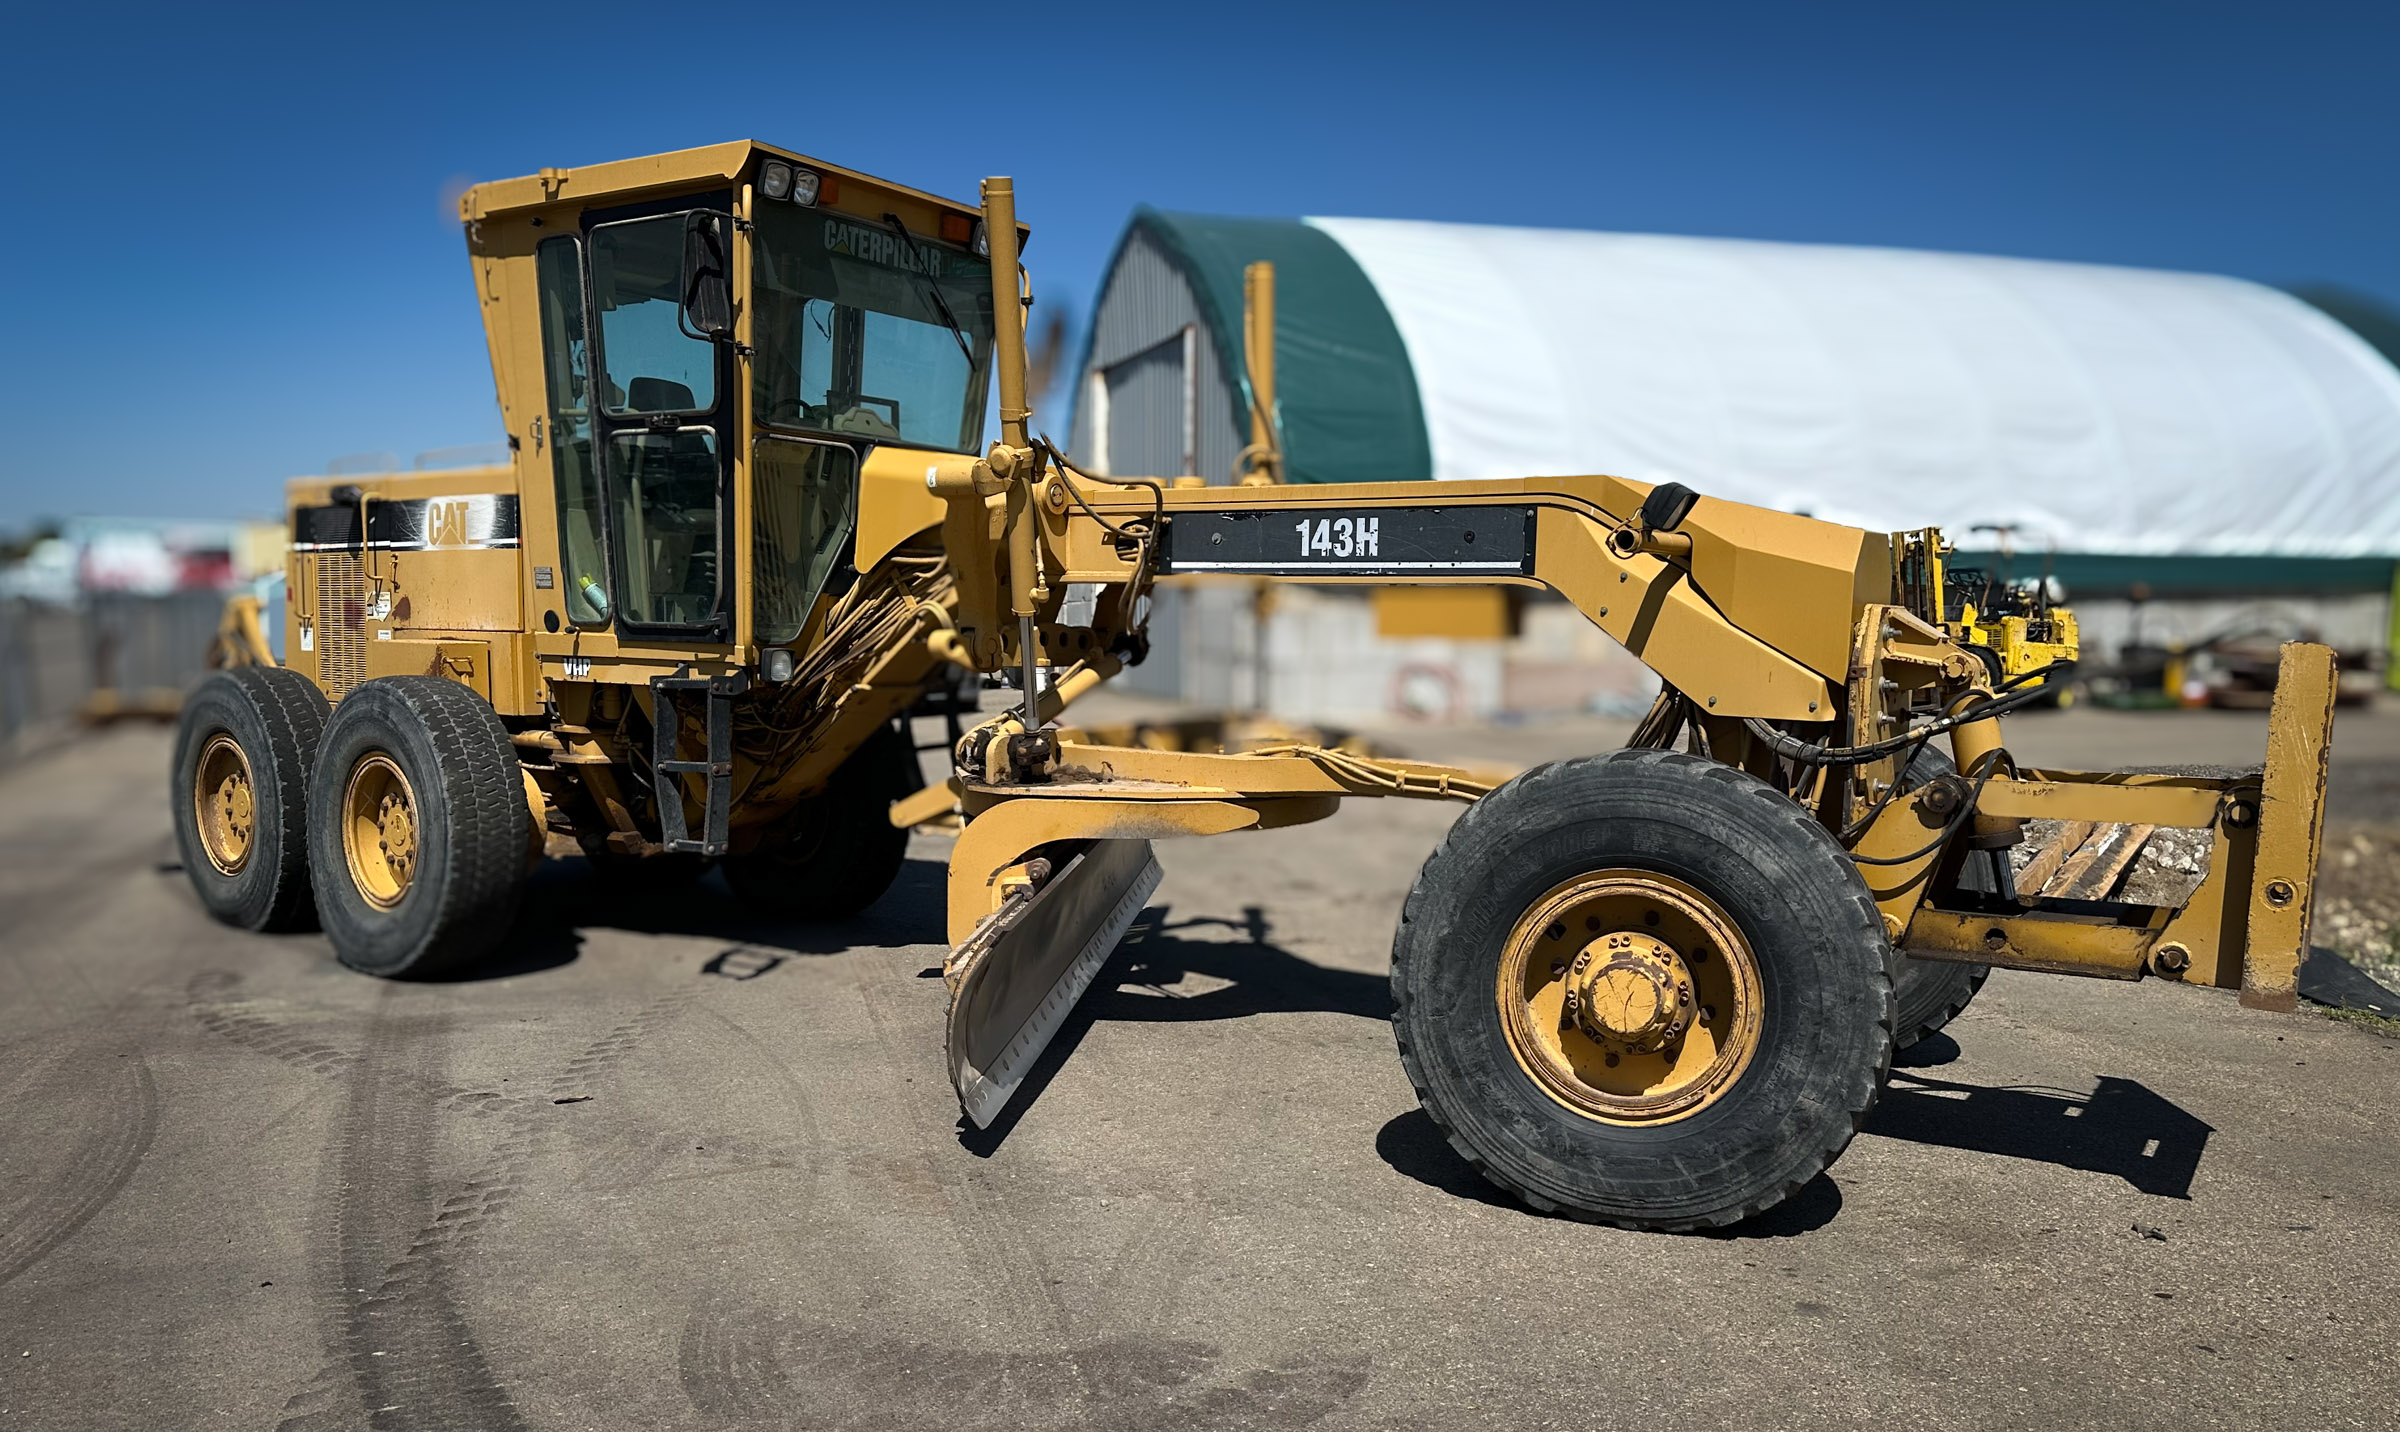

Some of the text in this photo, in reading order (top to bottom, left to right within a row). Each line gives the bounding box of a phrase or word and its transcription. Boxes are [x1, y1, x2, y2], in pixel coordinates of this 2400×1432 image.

[824, 219, 942, 279] CATERPILLAR
[428, 501, 470, 546] CAT
[1295, 517, 1379, 558] 143H
[563, 658, 591, 677] VHP
